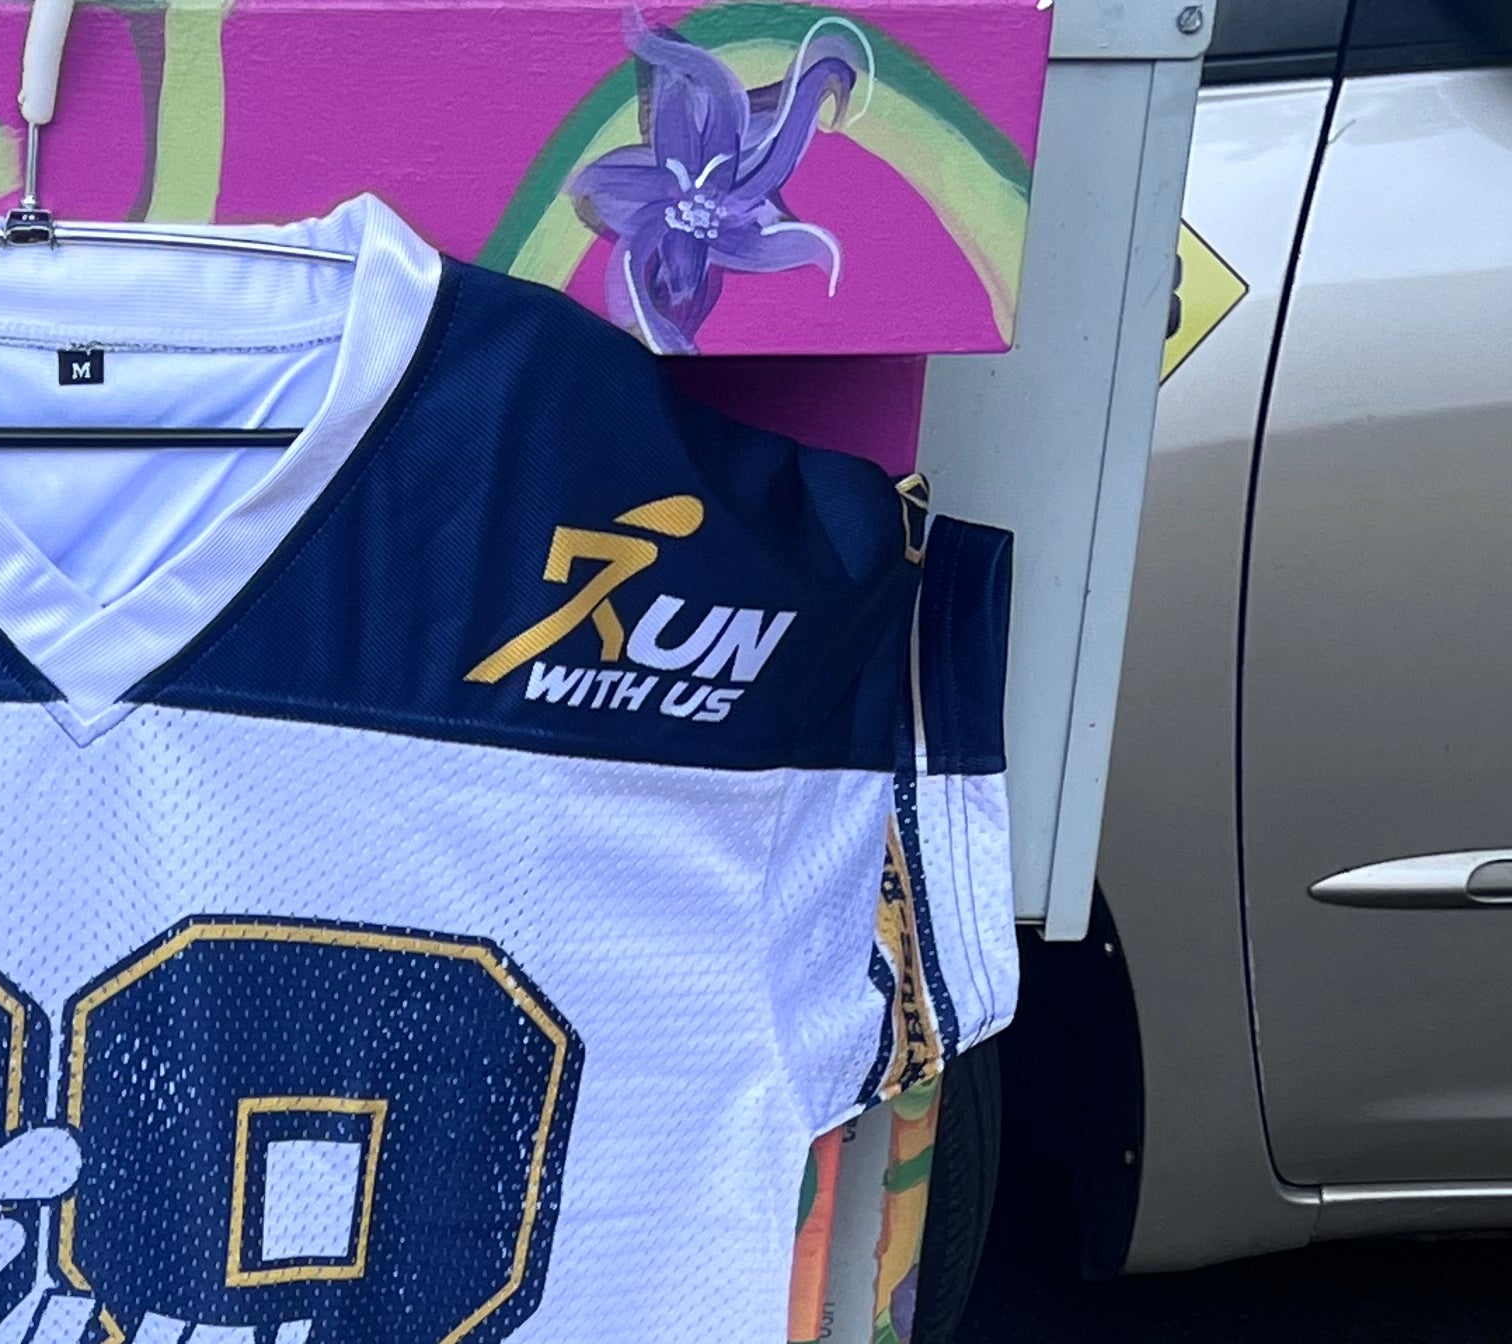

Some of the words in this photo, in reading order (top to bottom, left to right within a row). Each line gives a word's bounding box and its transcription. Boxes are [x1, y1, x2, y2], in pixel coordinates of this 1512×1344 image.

[72, 361, 91, 379] M
[524, 661, 660, 711] WITH
[659, 681, 744, 722] US
